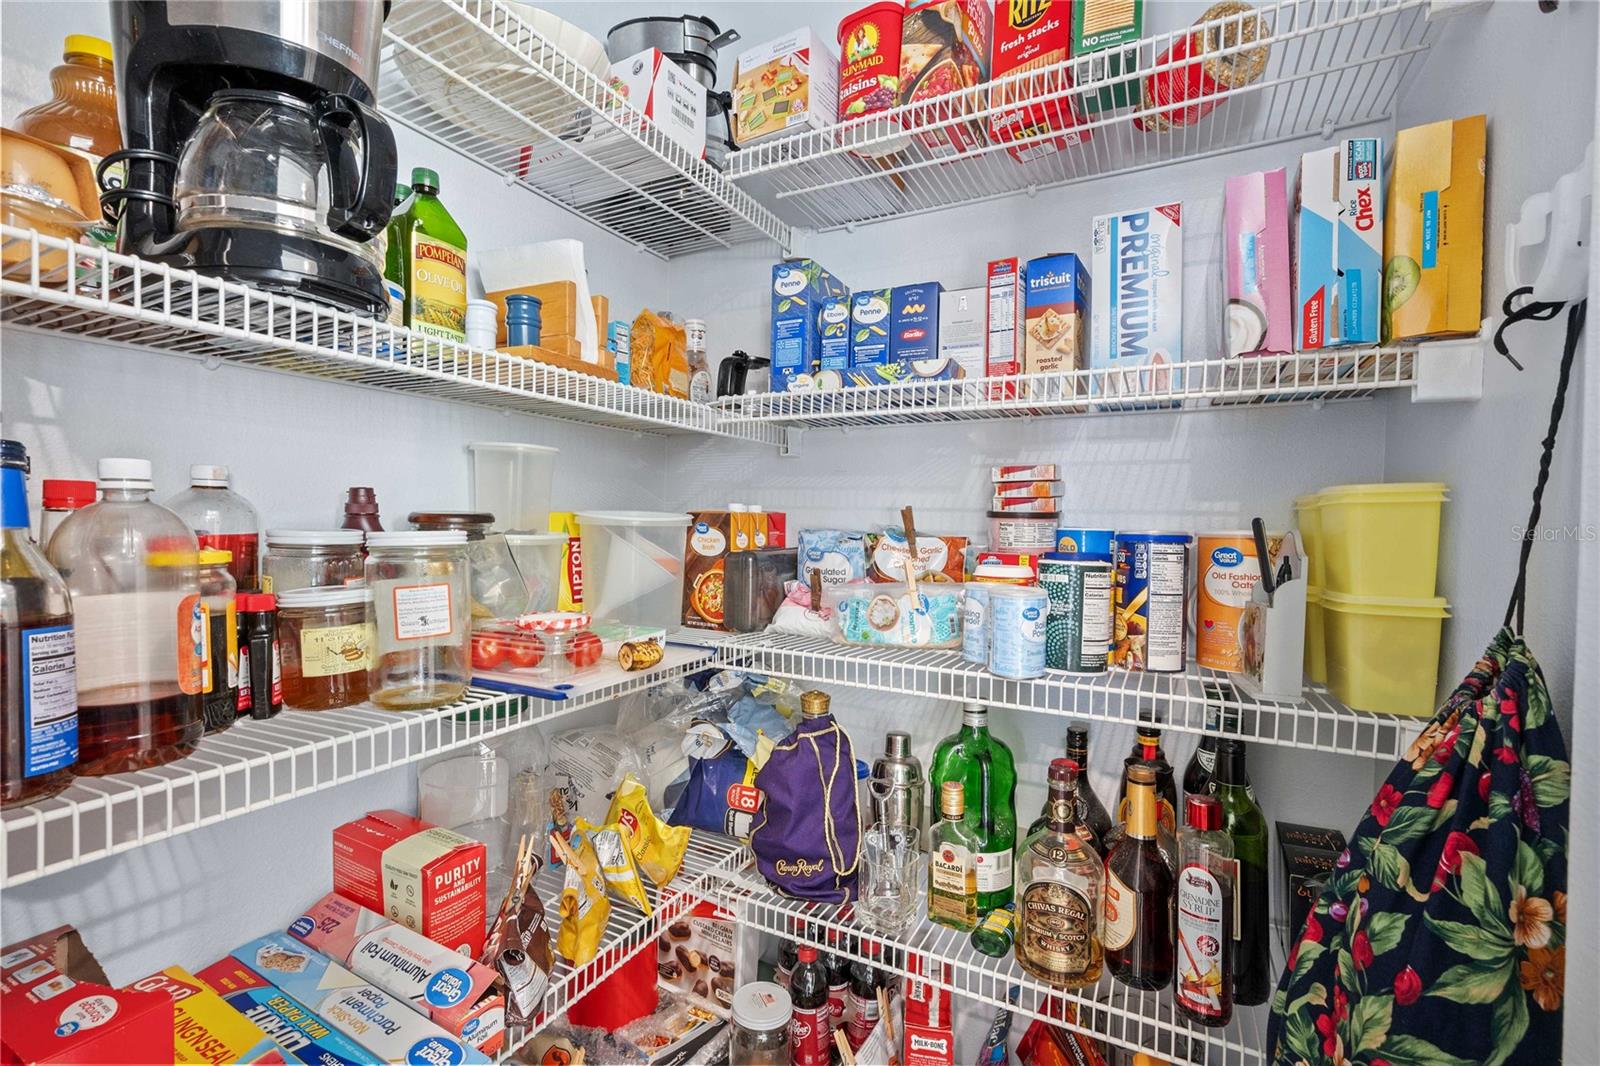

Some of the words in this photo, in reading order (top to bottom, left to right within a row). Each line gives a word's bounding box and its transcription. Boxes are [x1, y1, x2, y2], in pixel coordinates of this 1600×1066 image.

[1008, 0, 1053, 27] RITZ
[1001, 34, 1025, 53] fresh
[1027, 19, 1060, 41] stacks
[1082, 36, 1099, 48] NO
[1017, 45, 1040, 60] original
[1349, 199, 1357, 216] Rice
[1355, 186, 1374, 231] Chex
[419, 244, 466, 272] POMPEIAN
[1150, 233, 1170, 278] original
[416, 268, 448, 289] OLIVE
[450, 280, 465, 294] OIL
[781, 280, 801, 288] Penne
[1030, 272, 1071, 288] triscuit
[1121, 211, 1150, 357] PREMIUM
[860, 308, 881, 316] Penne
[1308, 300, 1318, 317] Free
[418, 325, 444, 338] LIGHT
[1308, 318, 1318, 344] Gluten
[1036, 355, 1063, 364] roasted
[1039, 362, 1059, 371] garlic
[697, 536, 721, 544] Chicken
[920, 545, 943, 554] Garlic
[1214, 551, 1238, 560] Great
[571, 540, 583, 601] LIPTON
[1212, 571, 1226, 580] Old
[822, 576, 847, 585] Sugar
[1231, 581, 1254, 589] Oats
[31, 634, 66, 644] Nutrition
[32, 662, 66, 674] Calories
[741, 790, 757, 808] 18
[1052, 849, 1063, 860] 12
[435, 857, 481, 890] PURITY
[776, 859, 798, 876] Crown
[797, 858, 824, 877] Royal
[434, 876, 481, 906] SUSTAINABILITY
[453, 878, 465, 888] AND
[1179, 888, 1220, 908] GRENADINE
[1027, 901, 1056, 913] CHIVAS
[1058, 907, 1086, 921] REGAL
[1182, 900, 1216, 917] SYRUP
[693, 919, 715, 933] CUSTARD
[714, 927, 733, 940] CREAM
[712, 921, 734, 935] BELGIAN
[1026, 922, 1053, 937] PREMIUM
[1059, 933, 1086, 941] SCOTCH
[712, 933, 733, 947] ECLAIRS
[1040, 940, 1071, 952] WHISKY
[360, 940, 381, 959] Foil
[379, 948, 432, 984] Aluminum
[441, 973, 462, 990] Value
[357, 988, 386, 1009] Paper
[432, 980, 462, 1003] Great
[267, 996, 304, 1023] PAPER
[340, 995, 402, 1036] Parchment
[297, 1017, 332, 1040] WAX
[326, 1005, 369, 1036] Non-Stick
[466, 1018, 499, 1044] Aluminum
[476, 1032, 489, 1044] Foil
[428, 1040, 453, 1057] Value
[913, 1038, 945, 1050] MILK-BONE
[414, 1045, 452, 1066] Great
